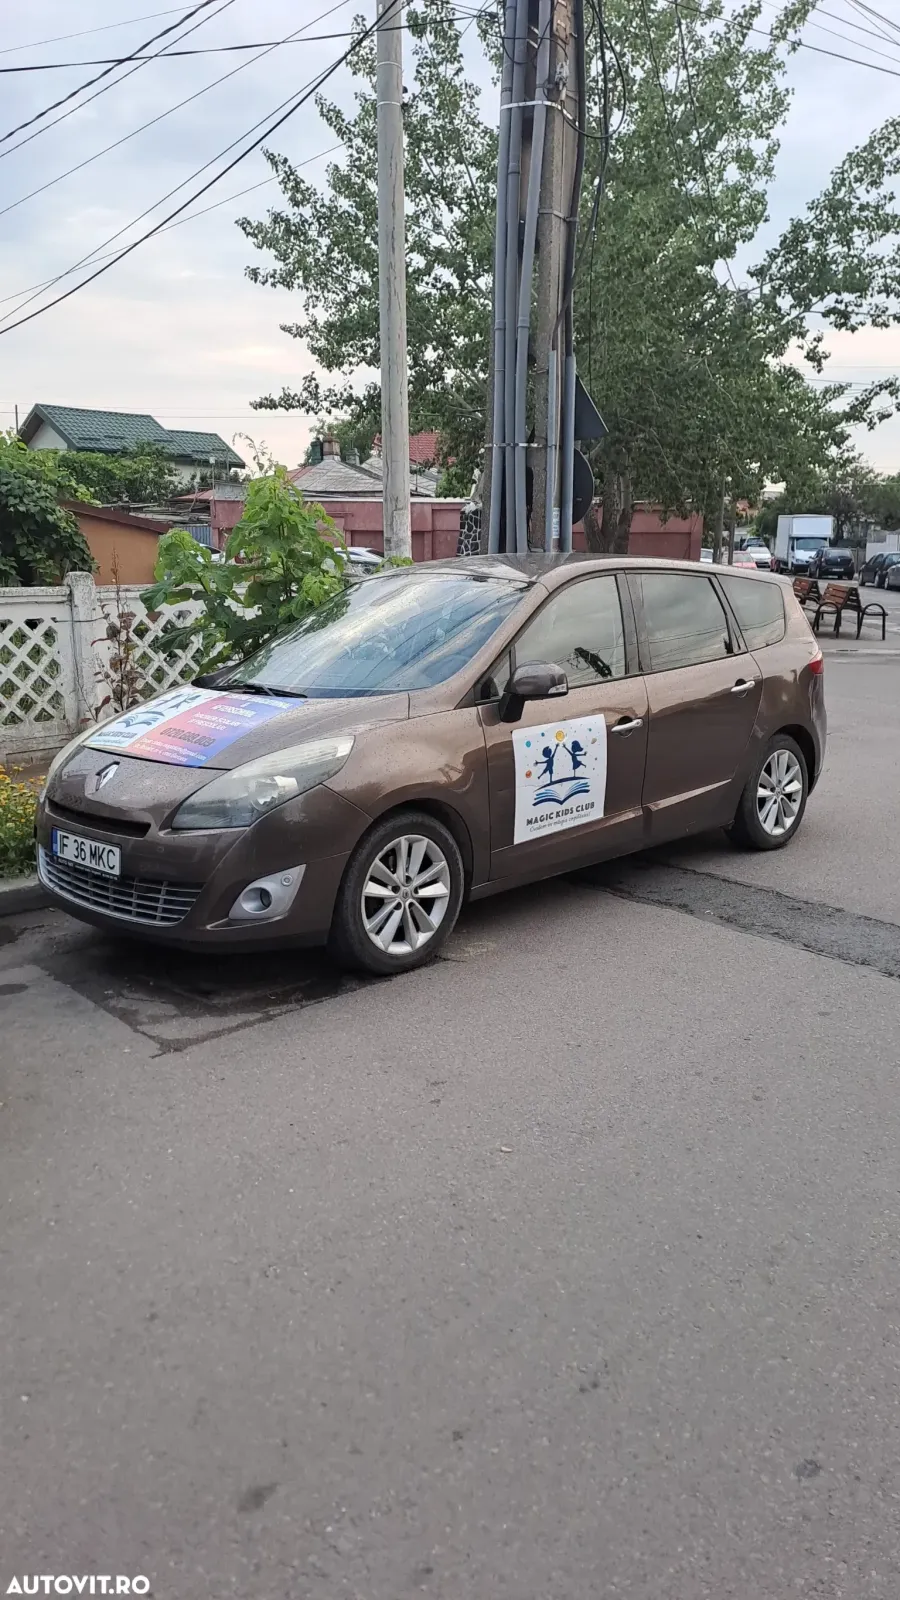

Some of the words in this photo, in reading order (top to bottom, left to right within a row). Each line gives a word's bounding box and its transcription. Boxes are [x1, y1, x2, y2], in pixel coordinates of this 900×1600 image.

[527, 813, 554, 826] MAGIC
[555, 807, 574, 819] KIDS
[575, 802, 595, 813] CLUB
[60, 833, 69, 855] IF
[73, 839, 87, 861] 36
[89, 843, 116, 870] MKC
